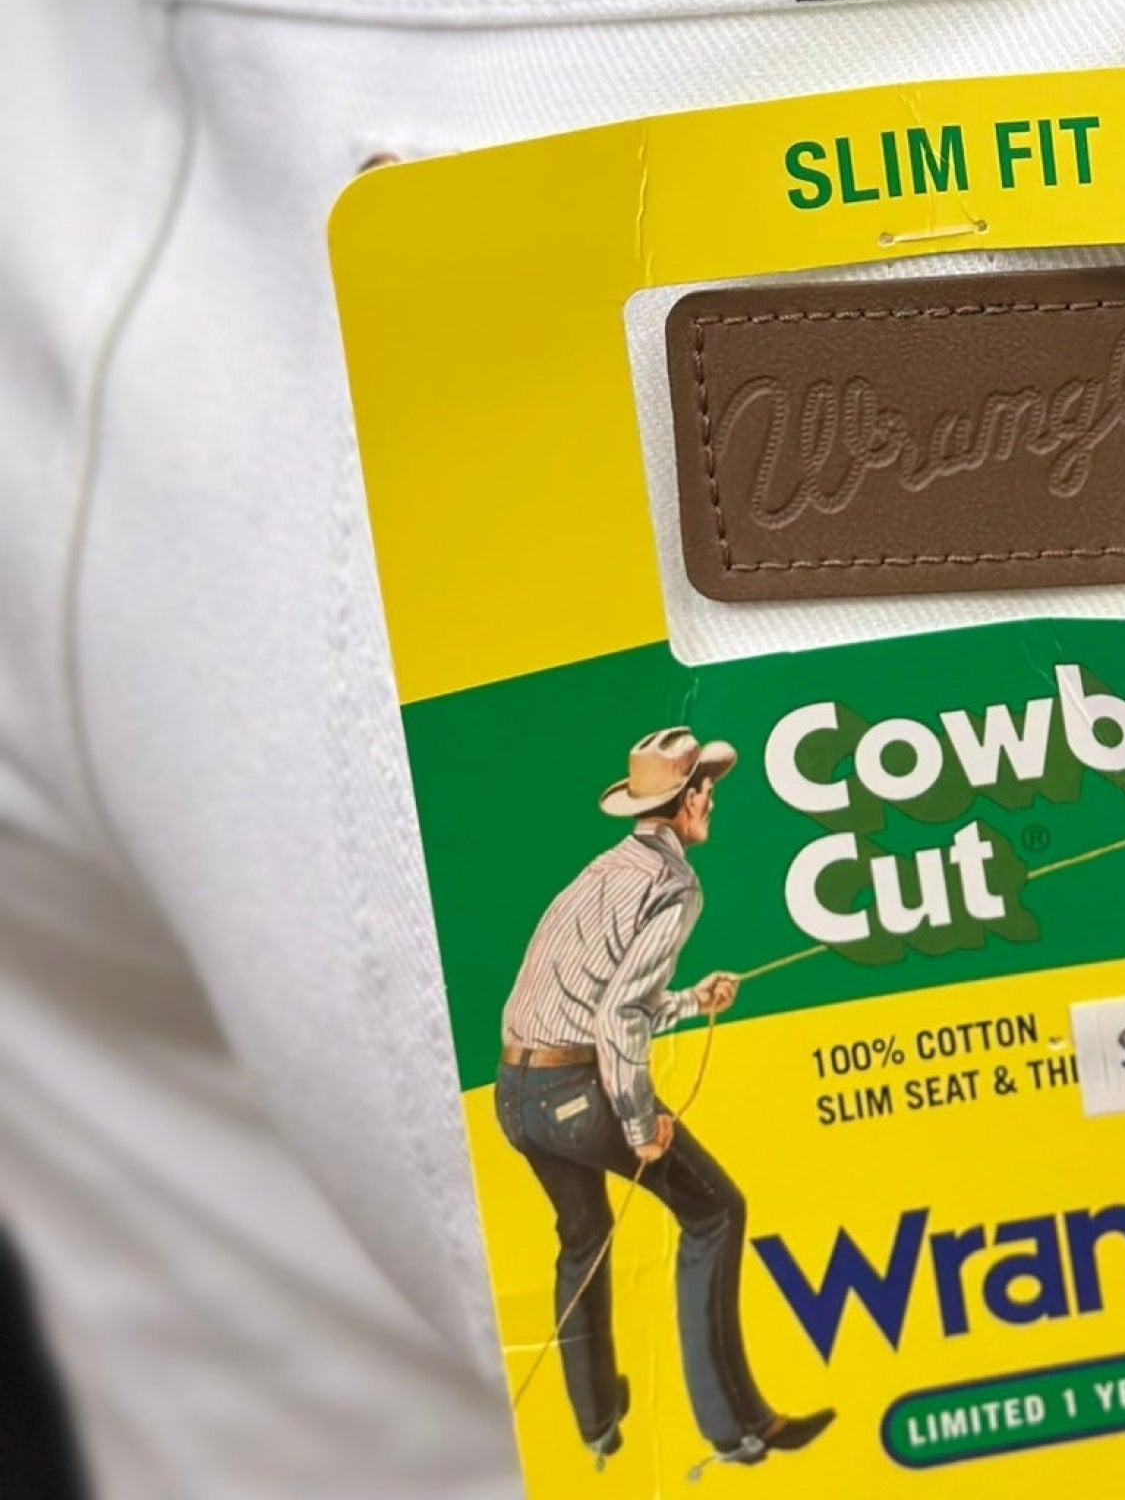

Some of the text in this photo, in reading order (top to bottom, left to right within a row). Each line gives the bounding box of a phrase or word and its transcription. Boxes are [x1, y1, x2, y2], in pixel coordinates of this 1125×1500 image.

[785, 116, 1101, 209] SLIM FIT
[784, 821, 1006, 943] Cut
[812, 1013, 1039, 1079] 100% COTTON
[815, 1054, 1080, 1126] SLIM SEAT & THI
[907, 1396, 1046, 1447] LIMITED
[1062, 1390, 1077, 1418] 1
